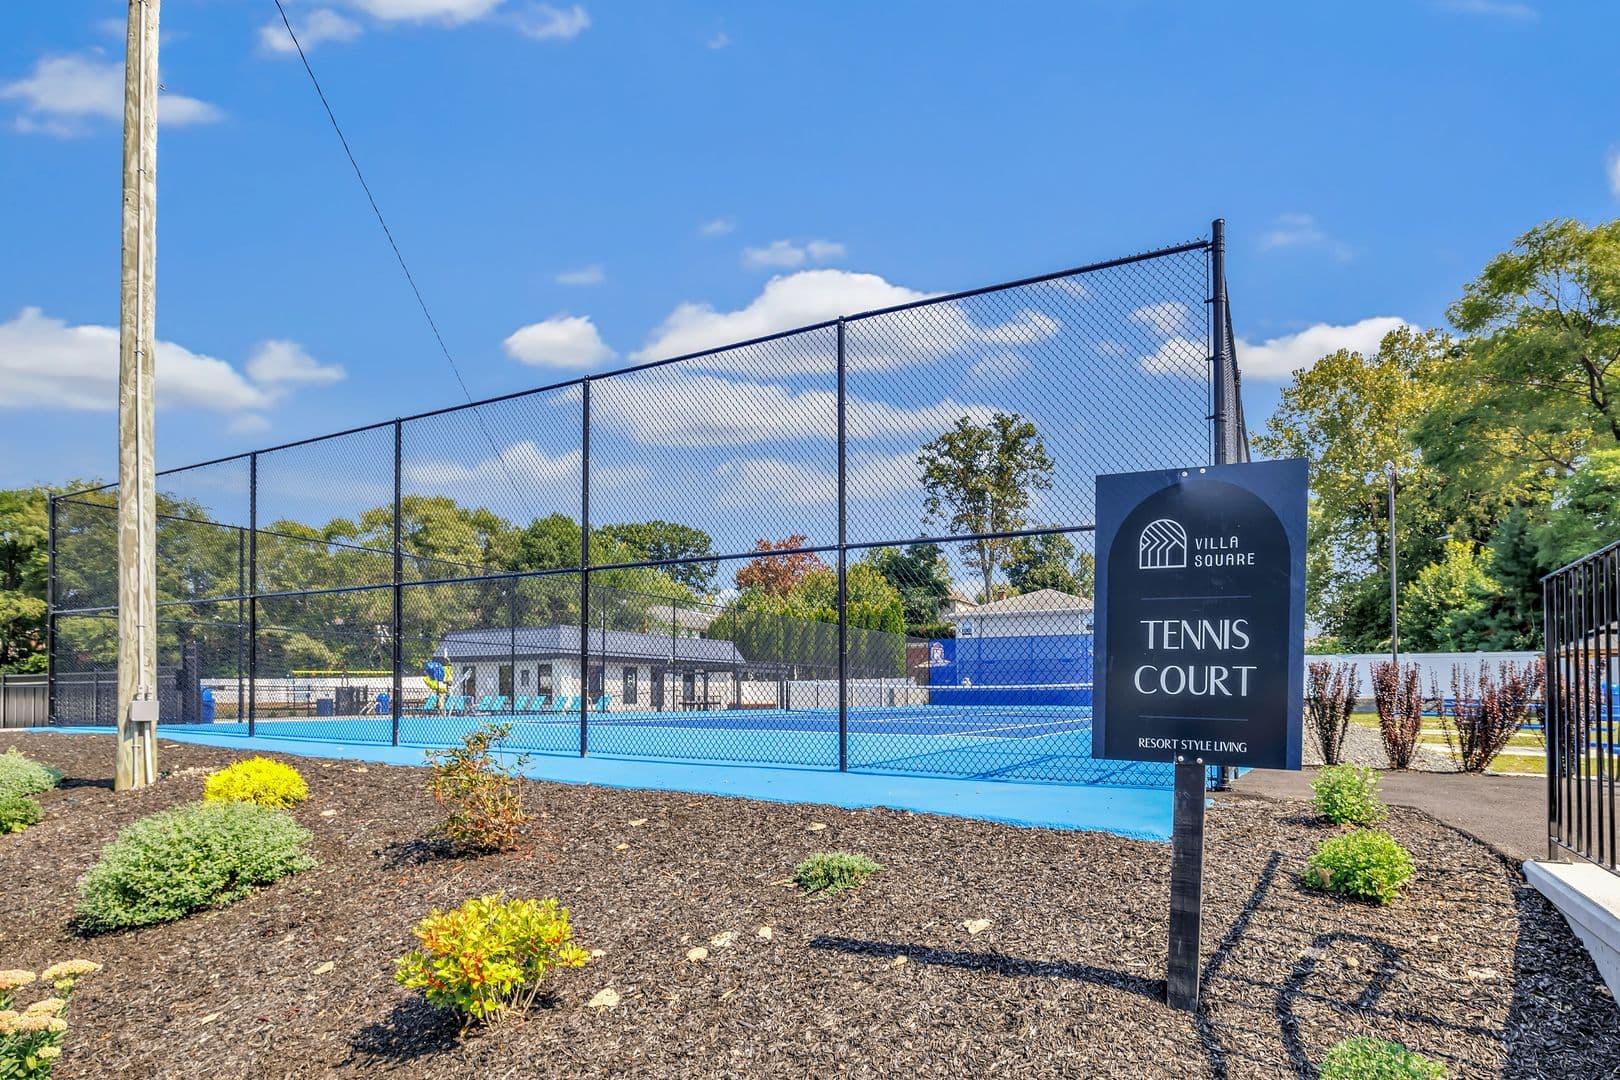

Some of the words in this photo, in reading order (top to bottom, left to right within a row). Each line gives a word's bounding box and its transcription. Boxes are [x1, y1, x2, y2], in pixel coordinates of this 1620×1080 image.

[1195, 536, 1239, 550] VILLA
[1195, 553, 1255, 567] SQUARE
[1140, 619, 1250, 650] TENNIS
[1134, 665, 1257, 696] COURT
[1138, 737, 1179, 749] RESORT
[1181, 739, 1212, 751] STYLE
[1214, 741, 1247, 753] LIVING
